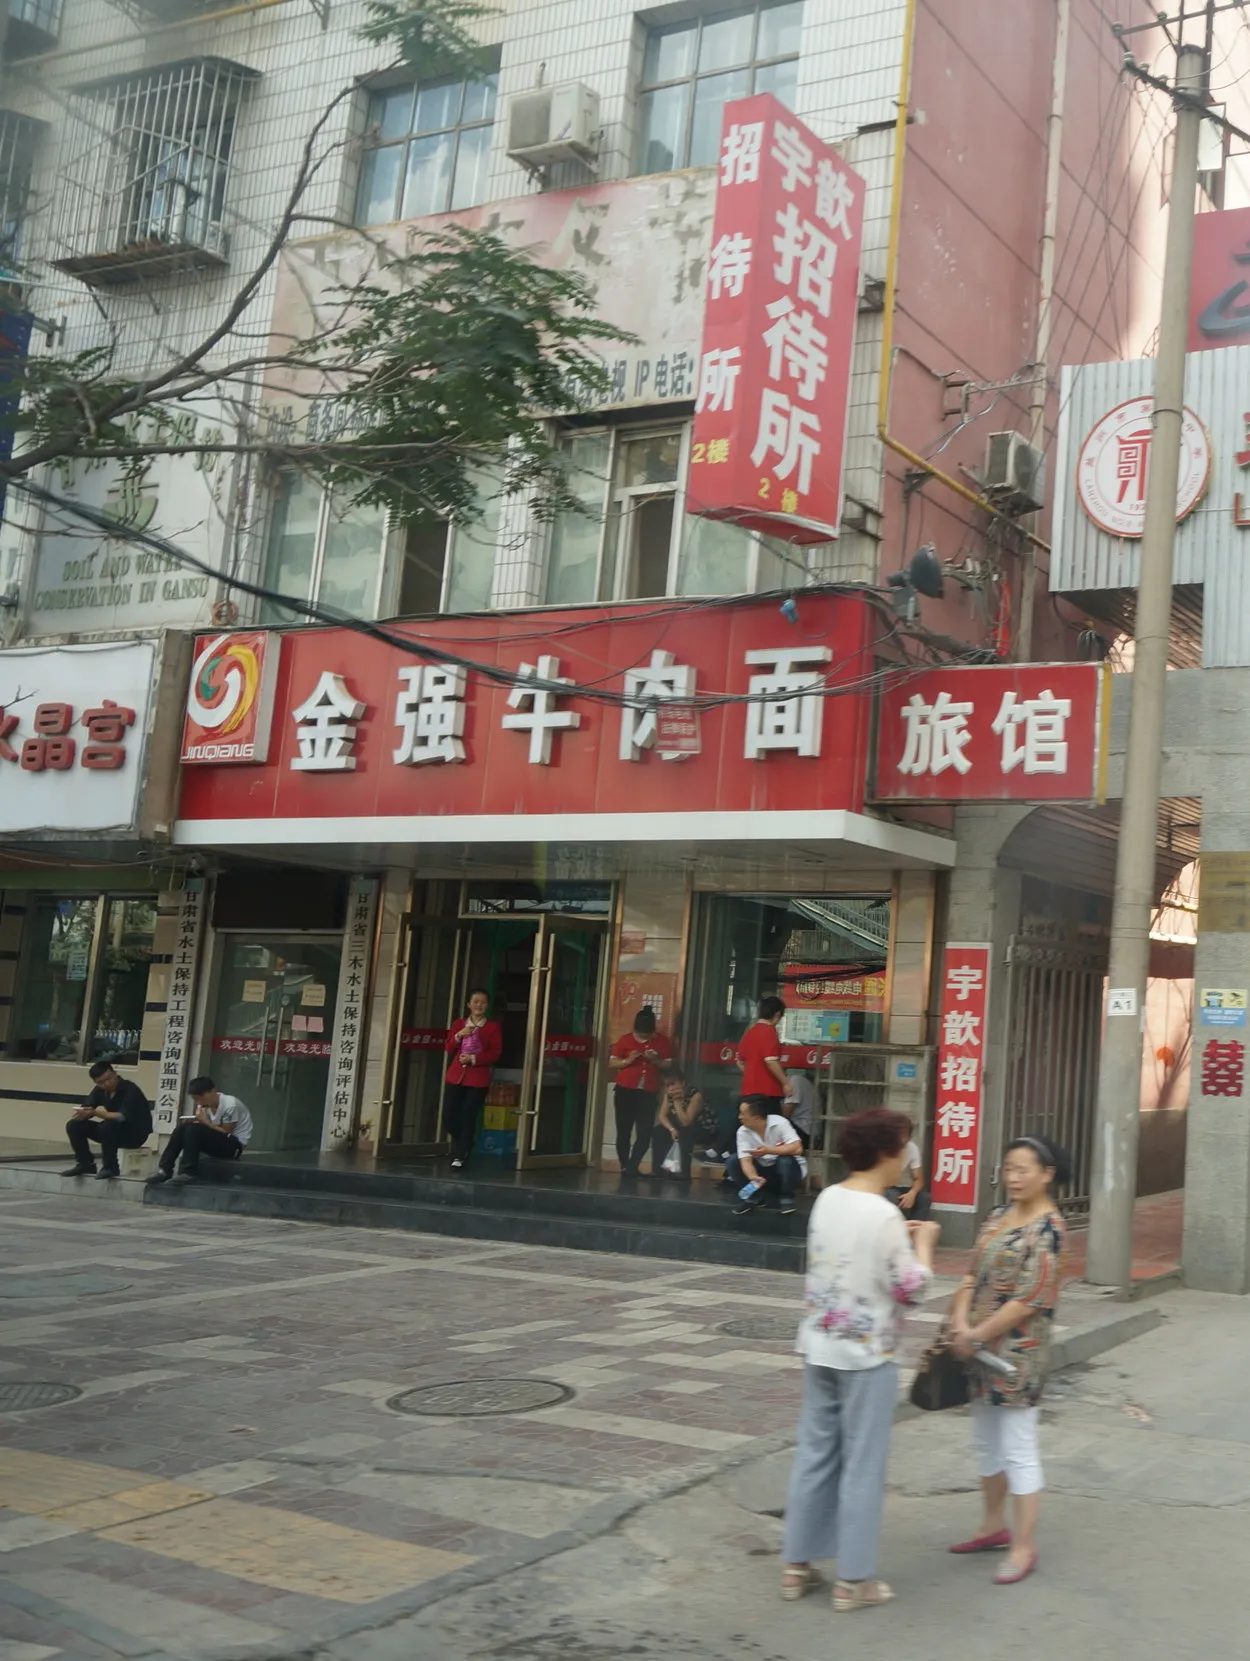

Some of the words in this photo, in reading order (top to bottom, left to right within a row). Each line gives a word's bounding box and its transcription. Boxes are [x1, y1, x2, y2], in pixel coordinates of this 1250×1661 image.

[696, 121, 764, 414] 招待所
[750, 208, 838, 496] 招待所
[691, 438, 730, 464] 2楼
[62, 557, 95, 582] SOIL
[99, 554, 131, 579] AND
[138, 580, 157, 604] IN
[162, 576, 210, 601] GANSU
[290, 647, 833, 772] 金强牛肉面
[896, 689, 1073, 776] 旅馆
[158, 890, 200, 1124] 甘肃省水土保持工程咨询监理公司
[1111, 1000, 1132, 1010] A1
[934, 965, 983, 1184] 宇歆招待所
